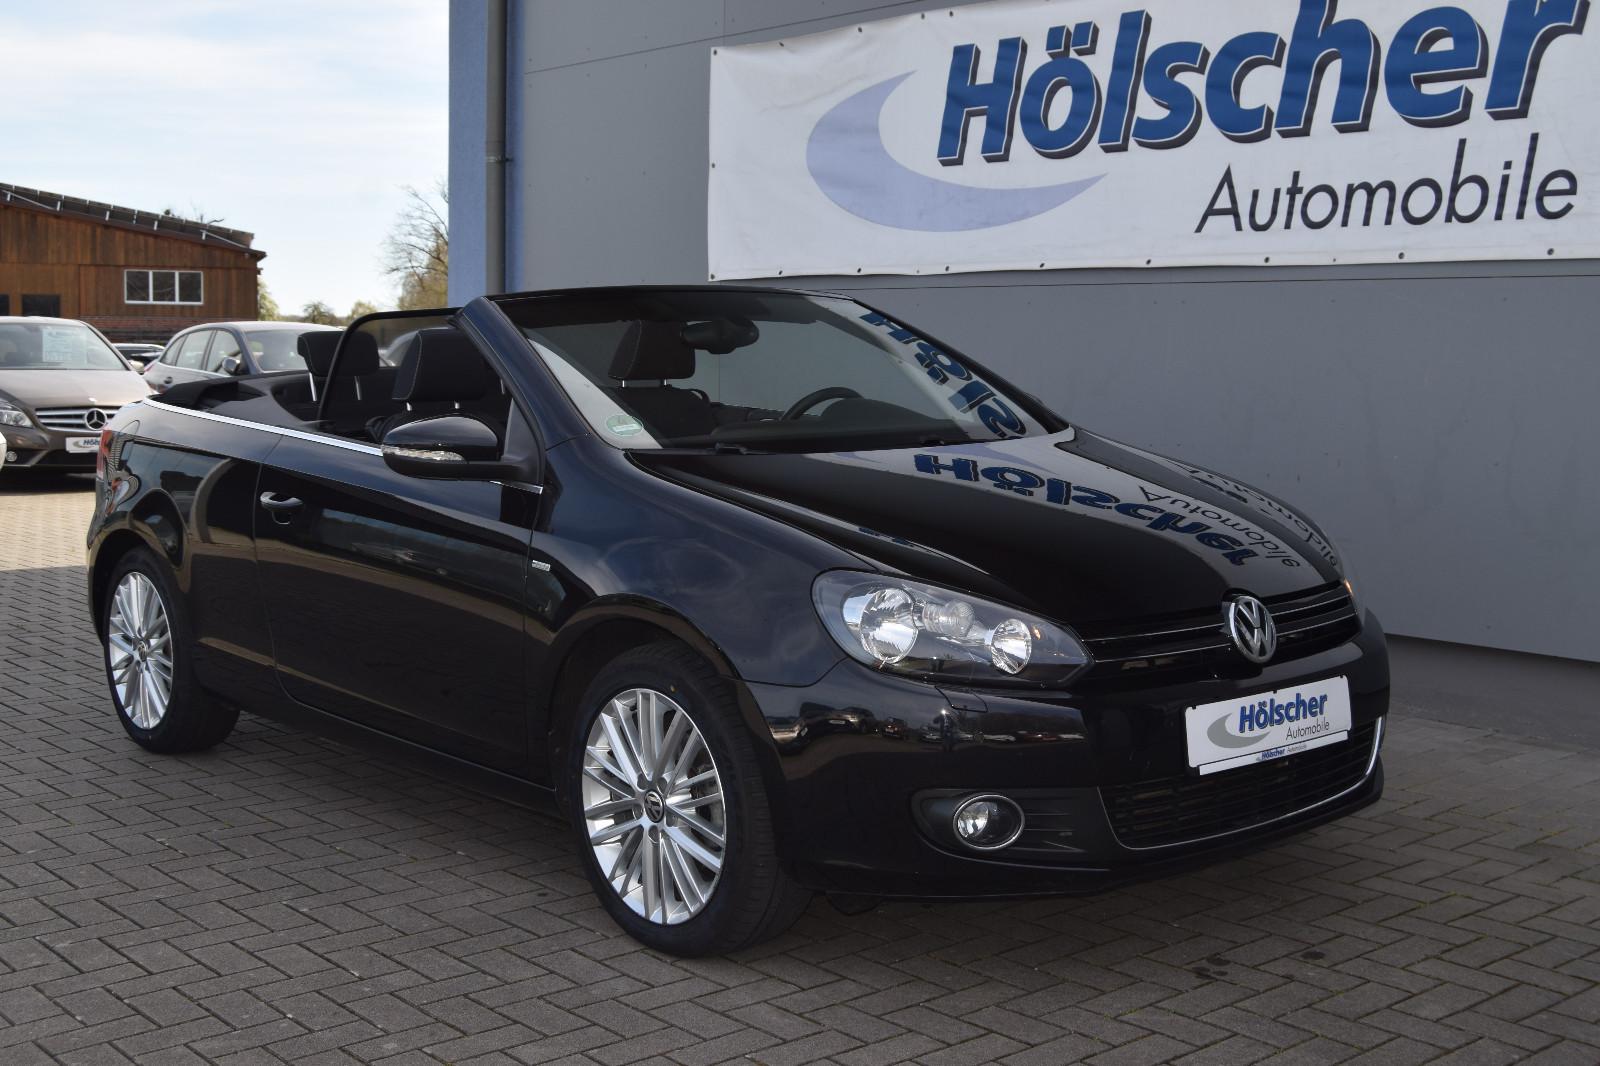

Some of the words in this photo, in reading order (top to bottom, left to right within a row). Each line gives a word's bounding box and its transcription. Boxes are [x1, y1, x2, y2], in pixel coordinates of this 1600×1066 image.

[937, 0, 1590, 167] Hölscher
[1195, 133, 1579, 233] Automobile
[1239, 693, 1328, 733] Hölscher
[1286, 717, 1330, 740] Automobile
